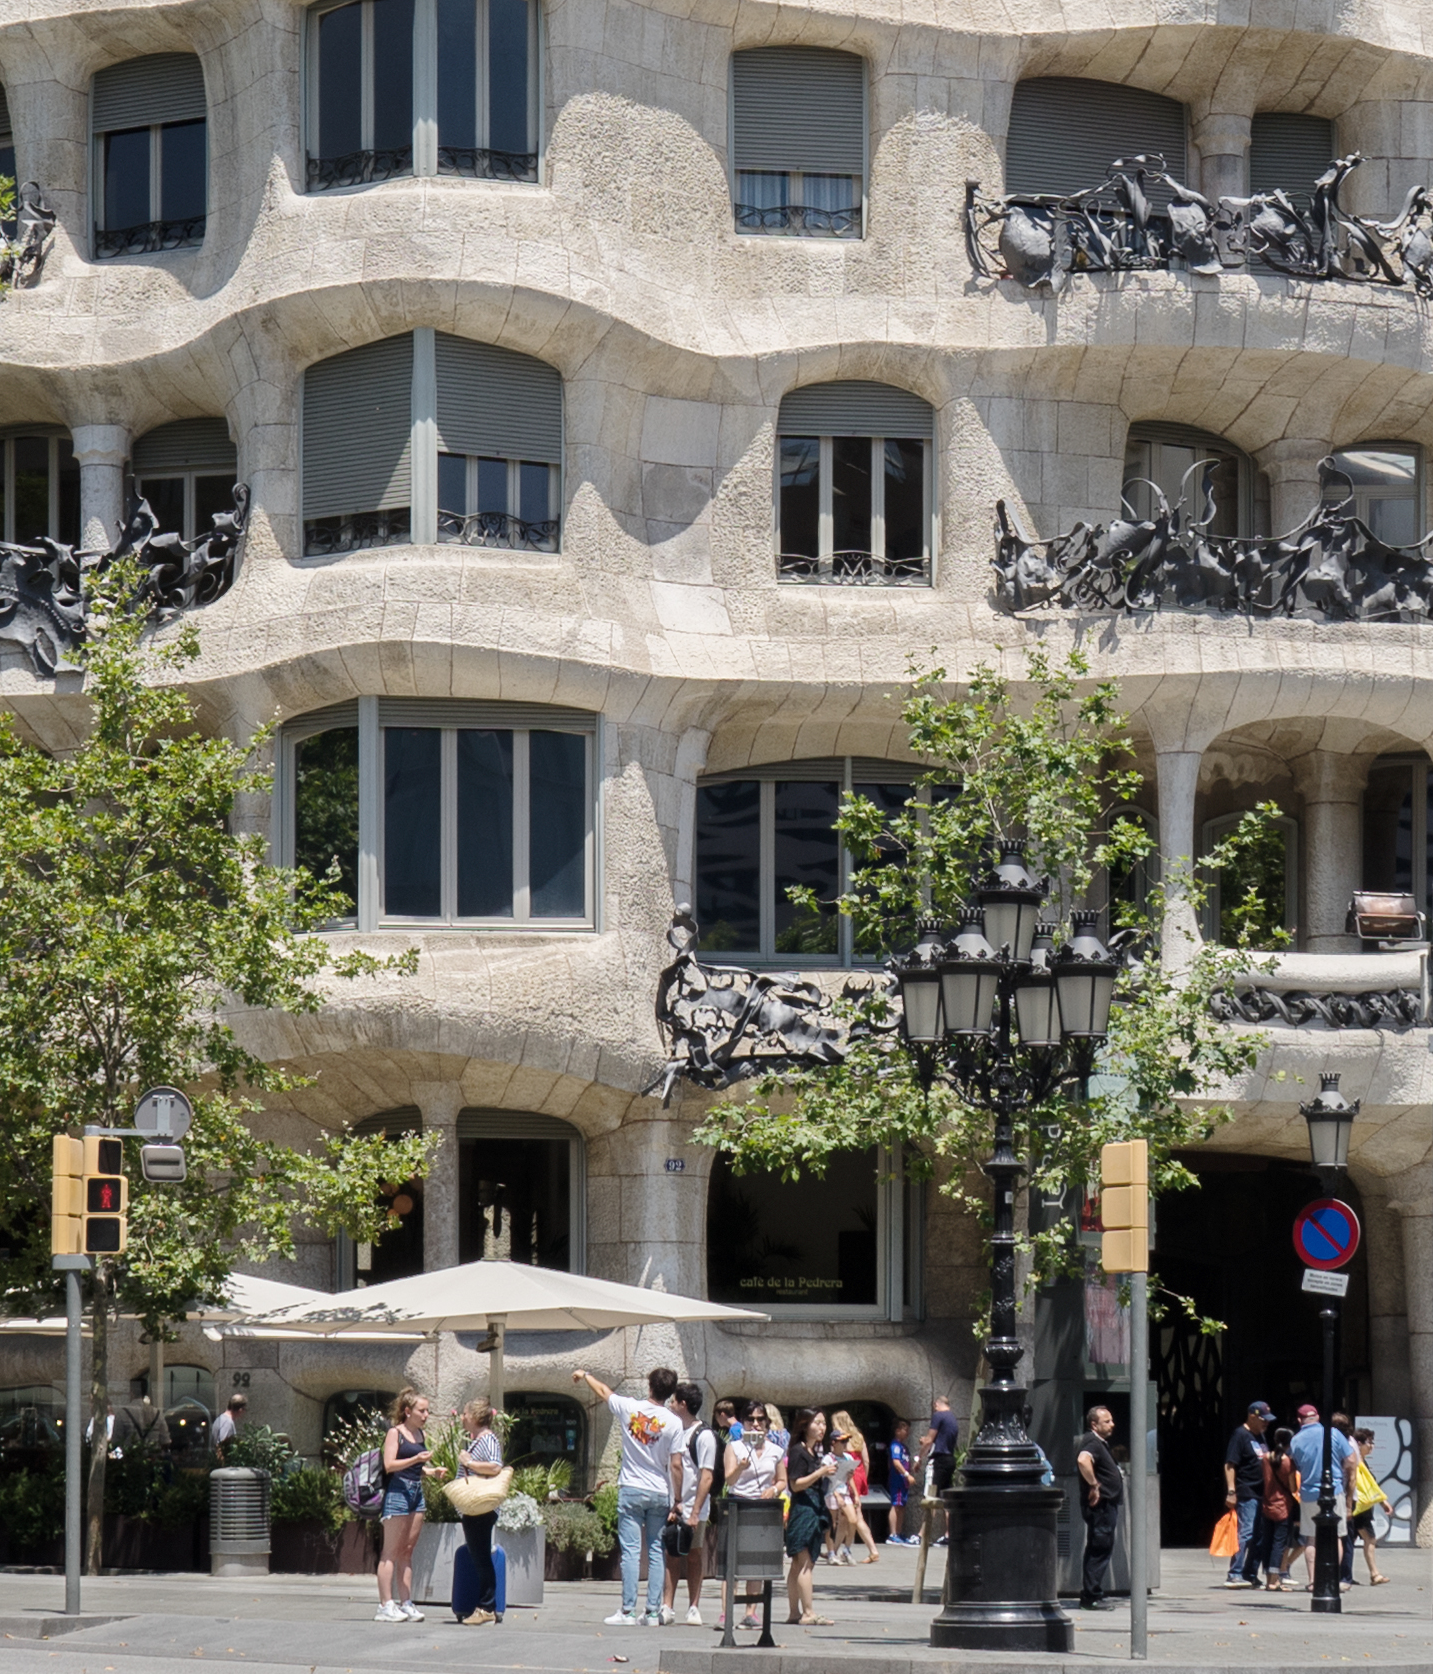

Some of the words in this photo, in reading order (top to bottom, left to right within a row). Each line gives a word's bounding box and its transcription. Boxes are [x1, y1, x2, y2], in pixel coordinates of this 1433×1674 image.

[767, 1276, 781, 1288] de
[785, 1276, 795, 1287] la
[799, 1276, 843, 1288] Pedrera
